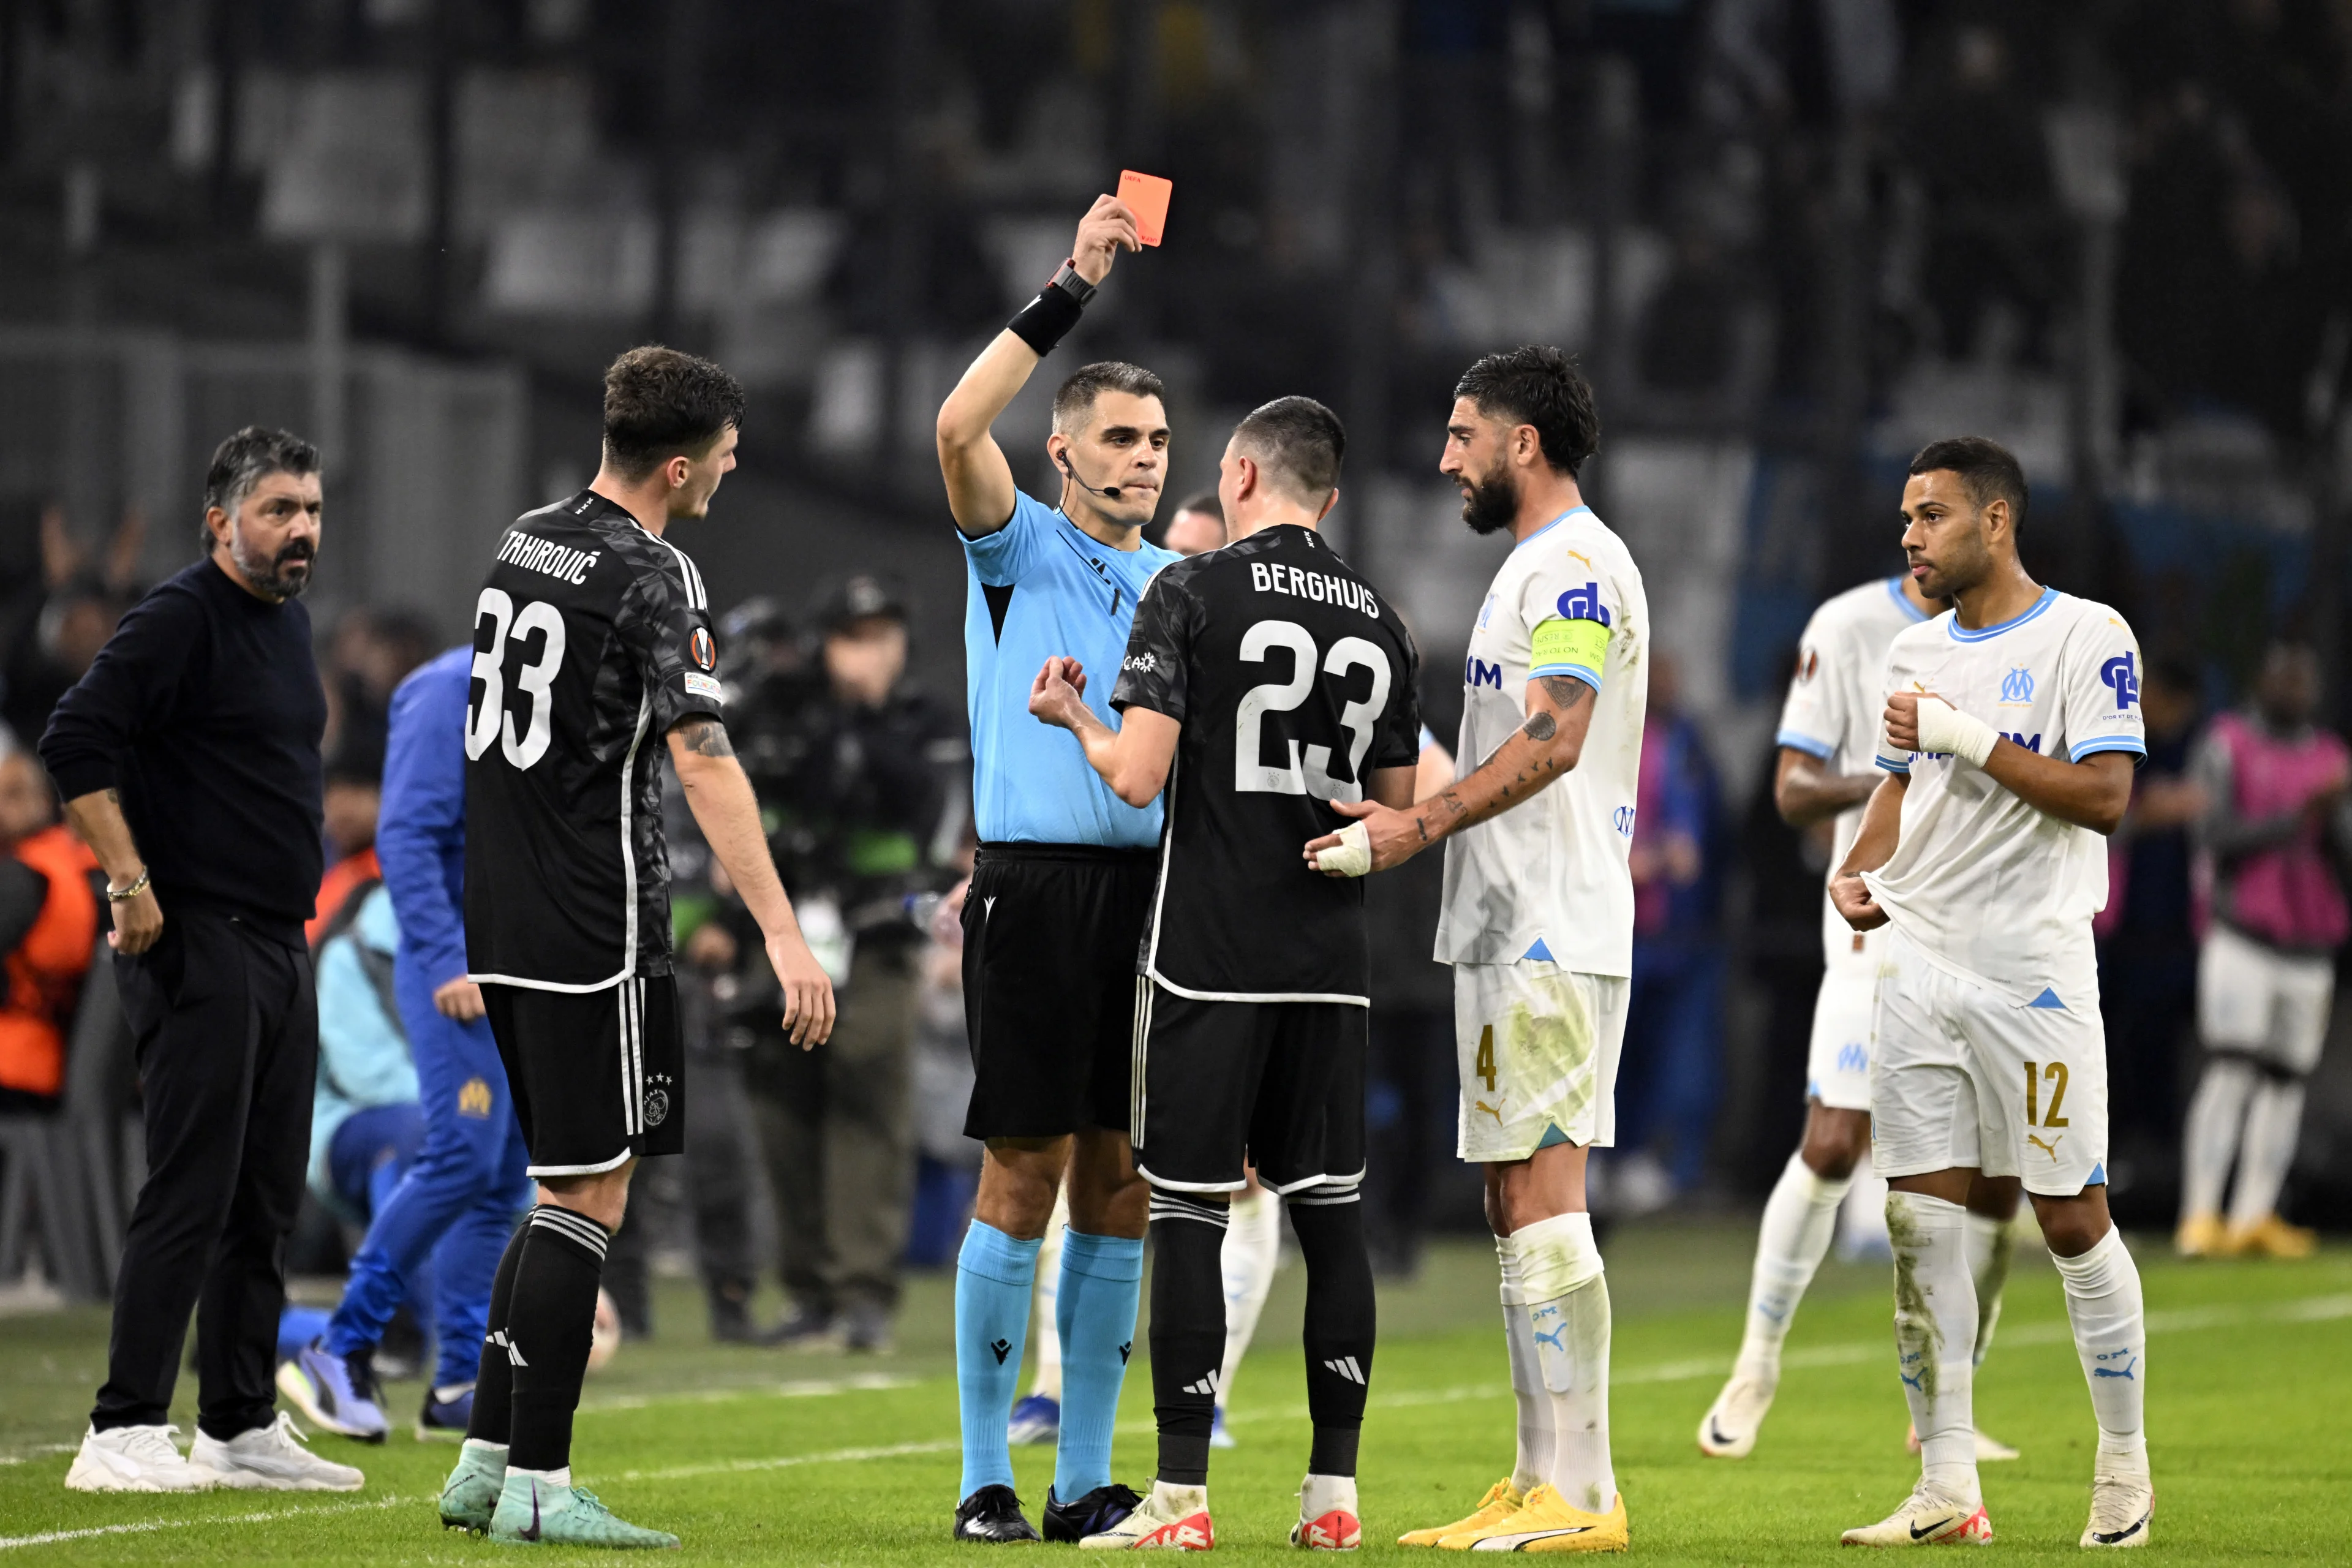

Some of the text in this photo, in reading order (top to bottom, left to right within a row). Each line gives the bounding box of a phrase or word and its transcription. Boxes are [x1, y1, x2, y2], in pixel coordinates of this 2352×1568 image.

[497, 530, 601, 585] TAHIROVIĆ
[1251, 562, 1379, 619] BERGHUIS
[464, 587, 565, 771] 33
[1235, 620, 1392, 802] 23
[1476, 1024, 1497, 1092] 4
[2024, 1061, 2069, 1128] 12
